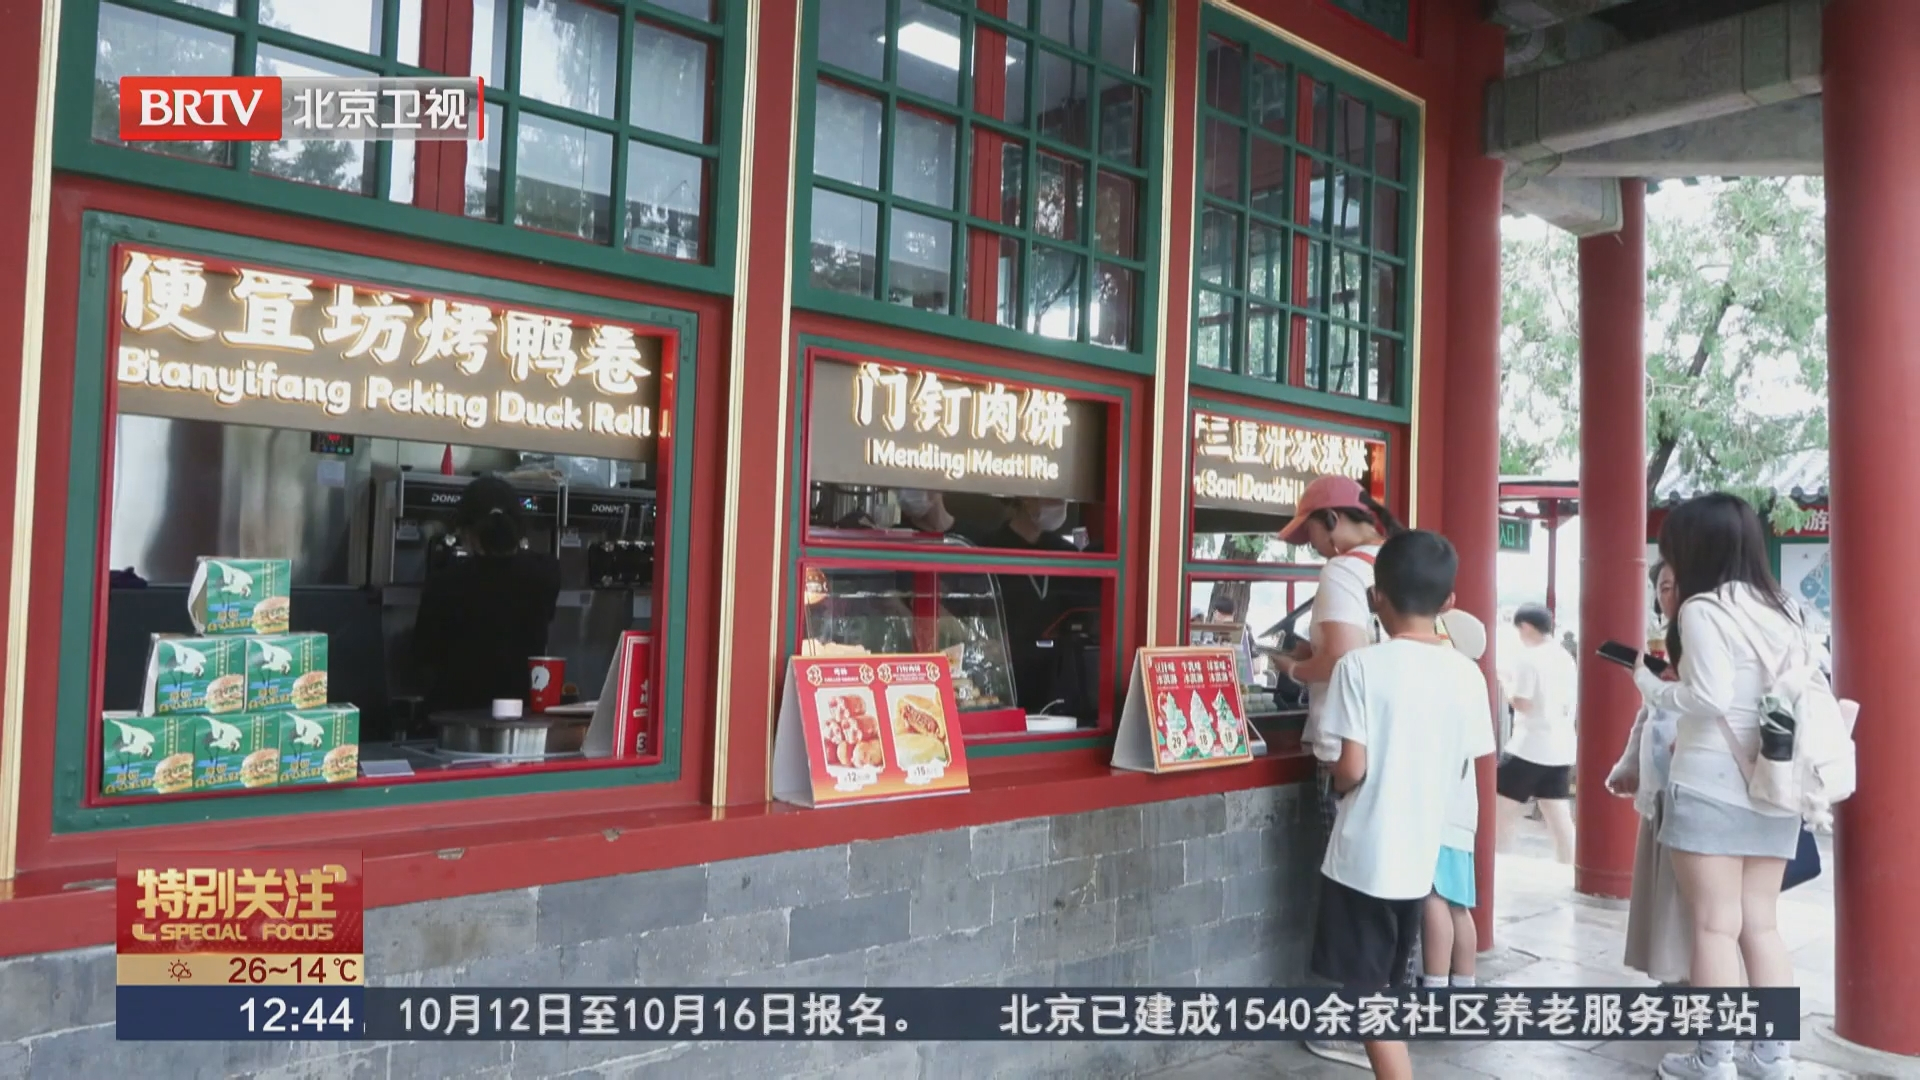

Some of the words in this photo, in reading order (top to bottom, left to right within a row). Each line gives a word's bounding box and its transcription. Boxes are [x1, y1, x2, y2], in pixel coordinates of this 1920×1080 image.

[121, 252, 651, 395] 便宜坊烤鸭卷
[118, 346, 351, 416] Bianyifang
[364, 375, 488, 428] Peking
[496, 390, 583, 431] Duck
[589, 401, 651, 438] Roll
[853, 362, 1071, 449] 门钉肉饼
[866, 438, 965, 480] Mending
[968, 448, 1026, 478] Meat
[1203, 469, 1237, 500] San
[1238, 472, 1293, 505] Douzhi
